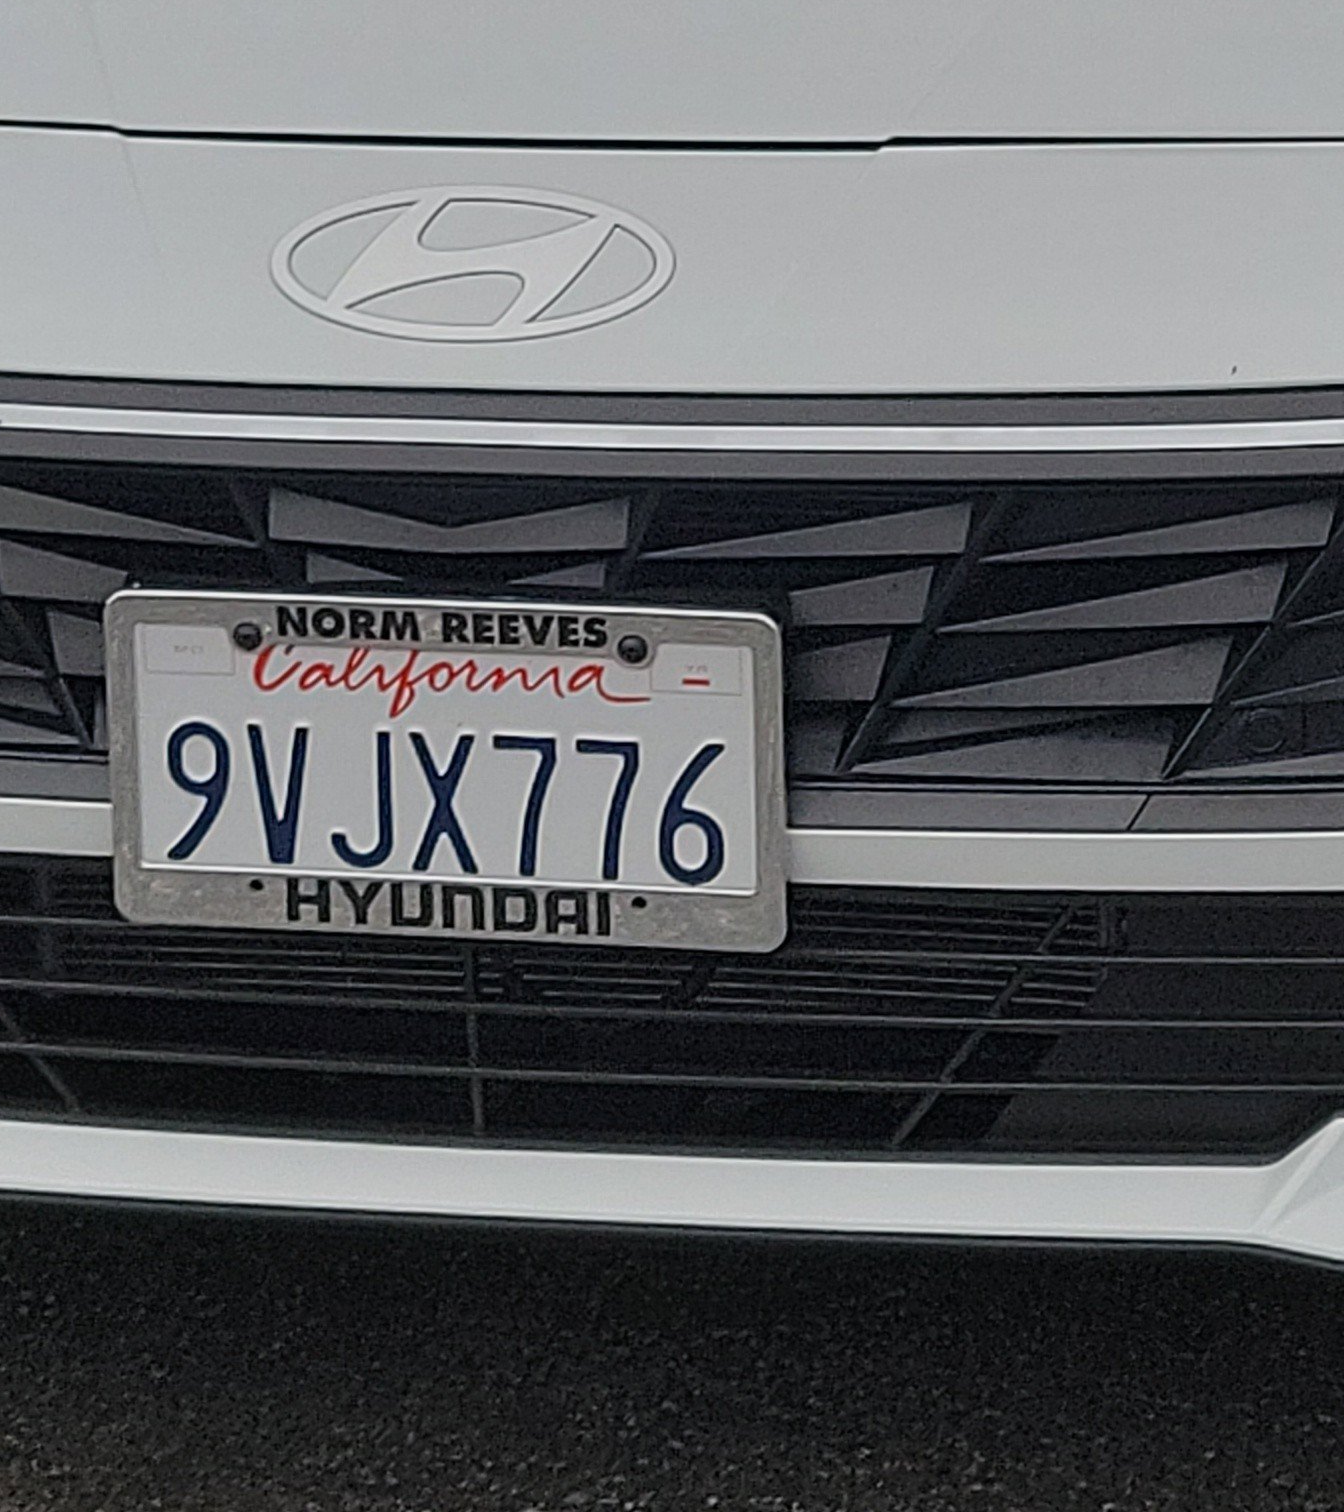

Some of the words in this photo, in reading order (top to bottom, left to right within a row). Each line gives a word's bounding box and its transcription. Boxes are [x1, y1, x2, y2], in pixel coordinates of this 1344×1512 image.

[276, 605, 421, 643] NORM
[441, 612, 609, 648] REEVES
[254, 643, 651, 719] California
[166, 721, 726, 886] 9VJX776
[286, 878, 611, 937] HYUNDAI
